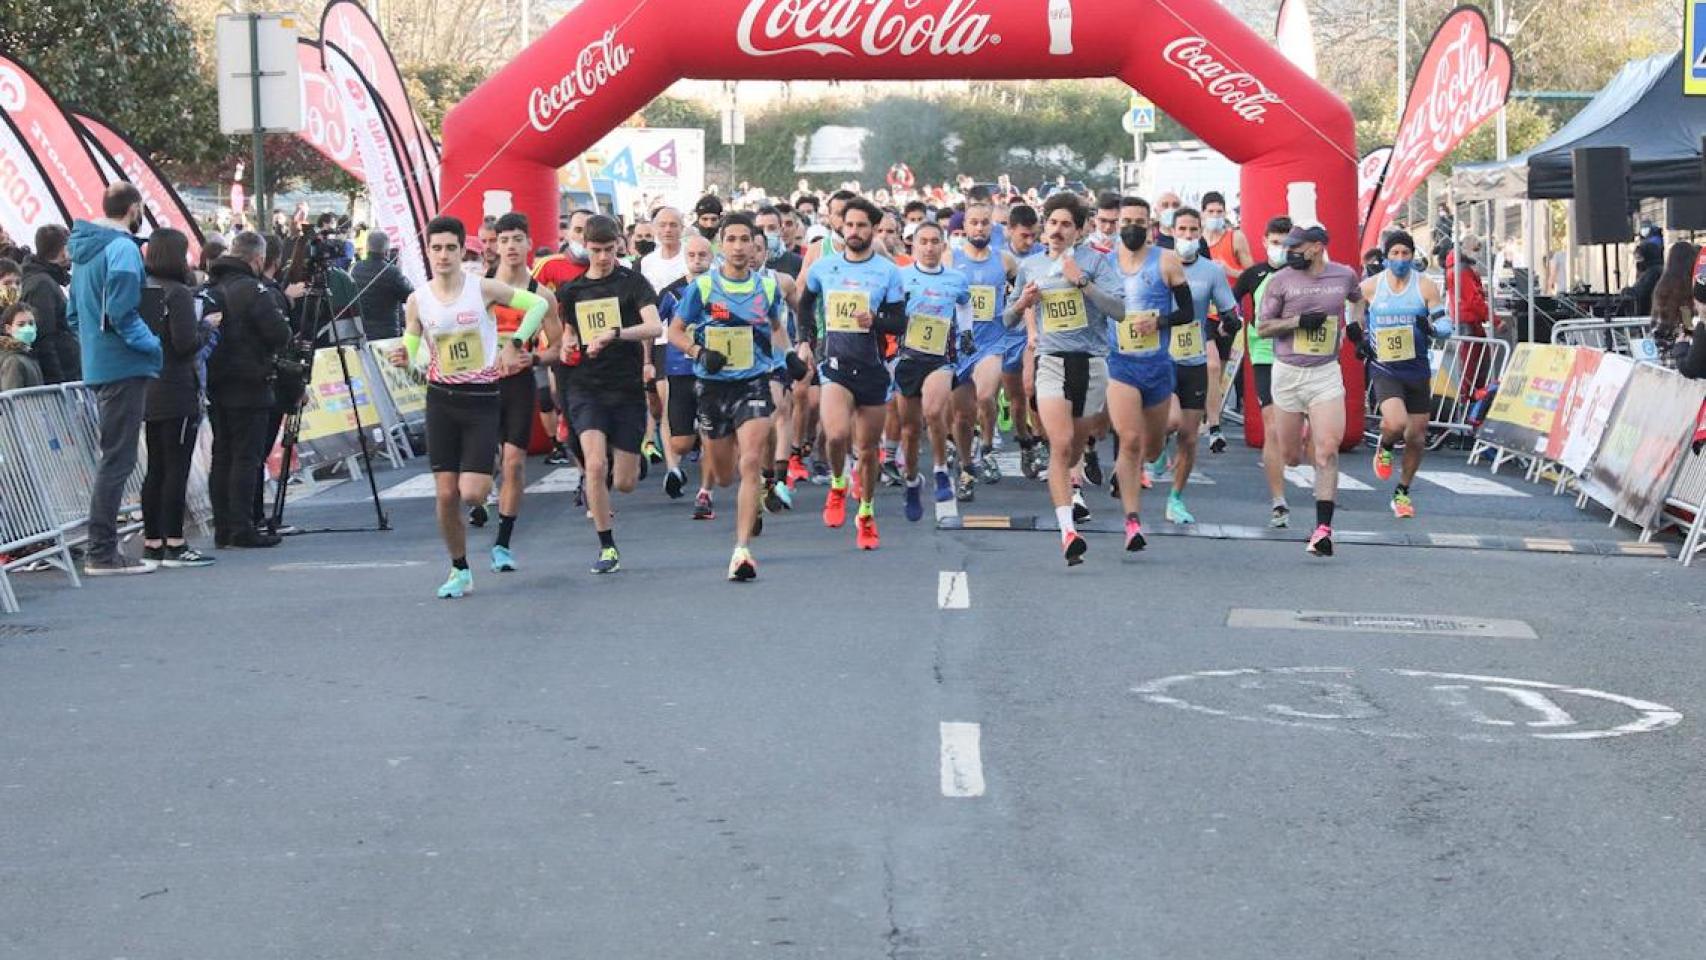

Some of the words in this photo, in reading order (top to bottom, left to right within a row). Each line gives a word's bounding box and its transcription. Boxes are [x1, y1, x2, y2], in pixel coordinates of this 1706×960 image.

[612, 156, 628, 178] 4
[659, 148, 673, 169] 5
[836, 302, 857, 319] 142
[1047, 299, 1077, 319] 1609
[587, 311, 606, 329] 118
[923, 326, 933, 341] 3
[1387, 335, 1402, 350] 39
[449, 341, 469, 360] 119
